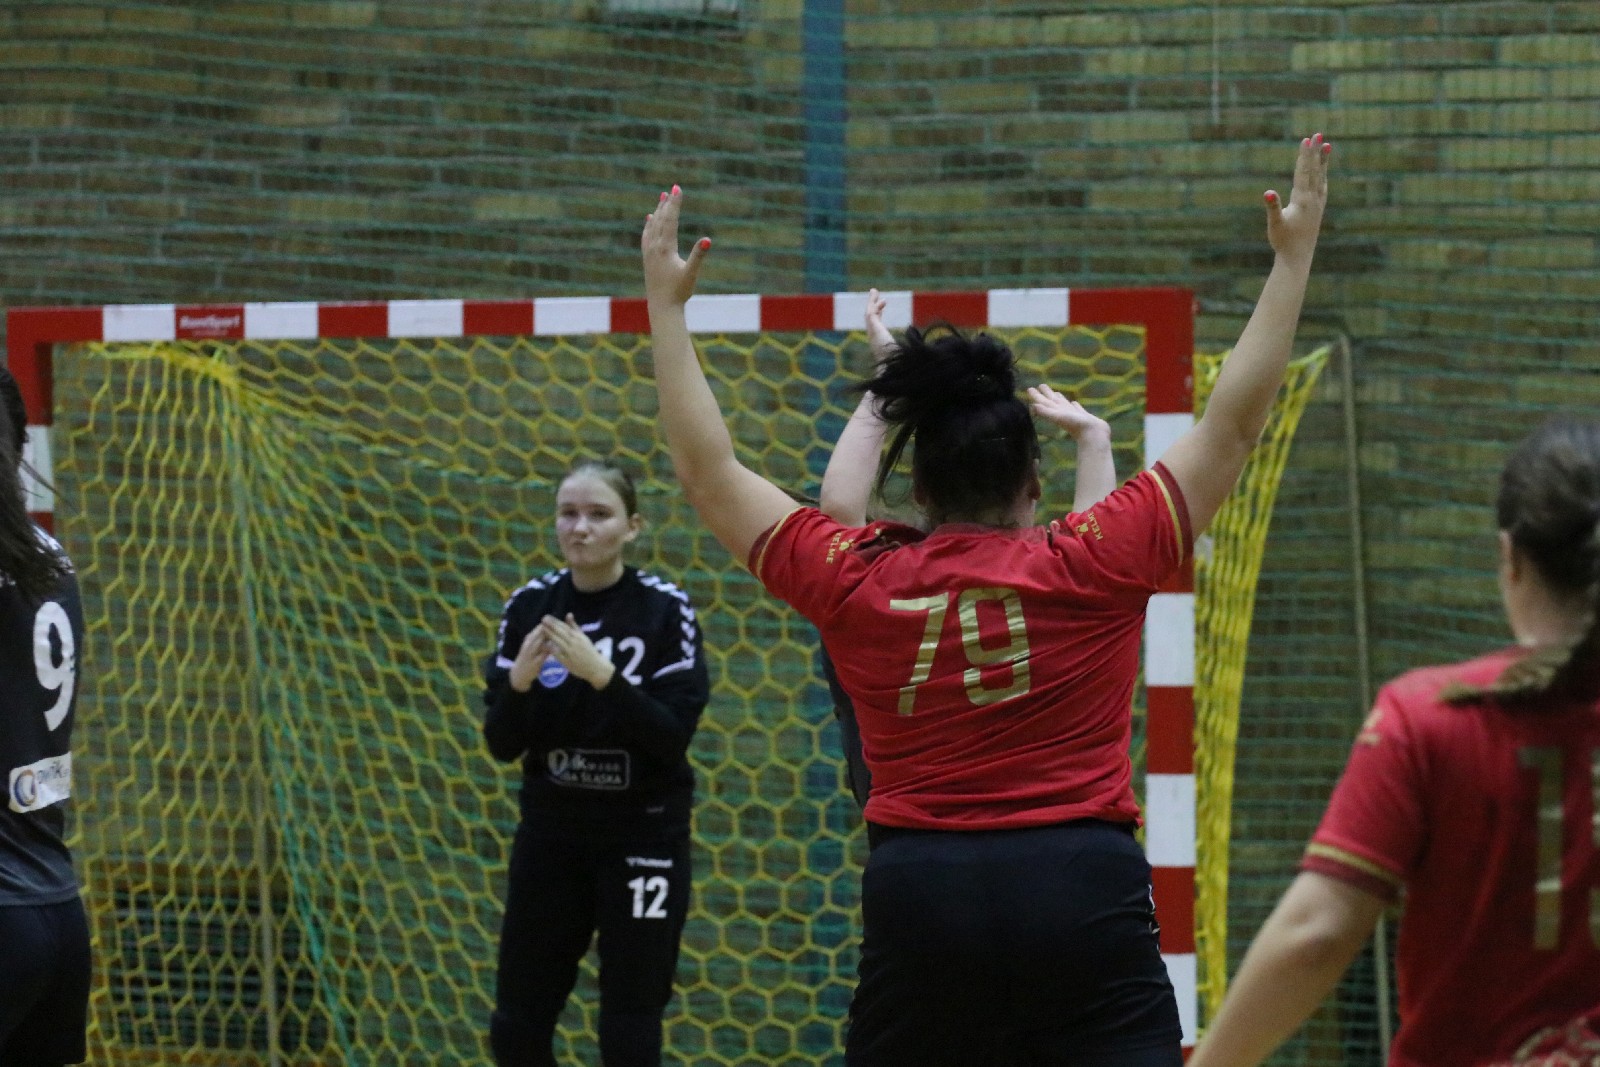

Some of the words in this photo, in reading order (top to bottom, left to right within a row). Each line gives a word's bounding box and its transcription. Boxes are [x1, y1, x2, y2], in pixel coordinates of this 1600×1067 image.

[826, 532, 842, 564] KELME
[33, 601, 75, 731] 9
[890, 586, 1032, 717] 79
[627, 875, 669, 919] 12
[1516, 746, 1600, 951] 1
